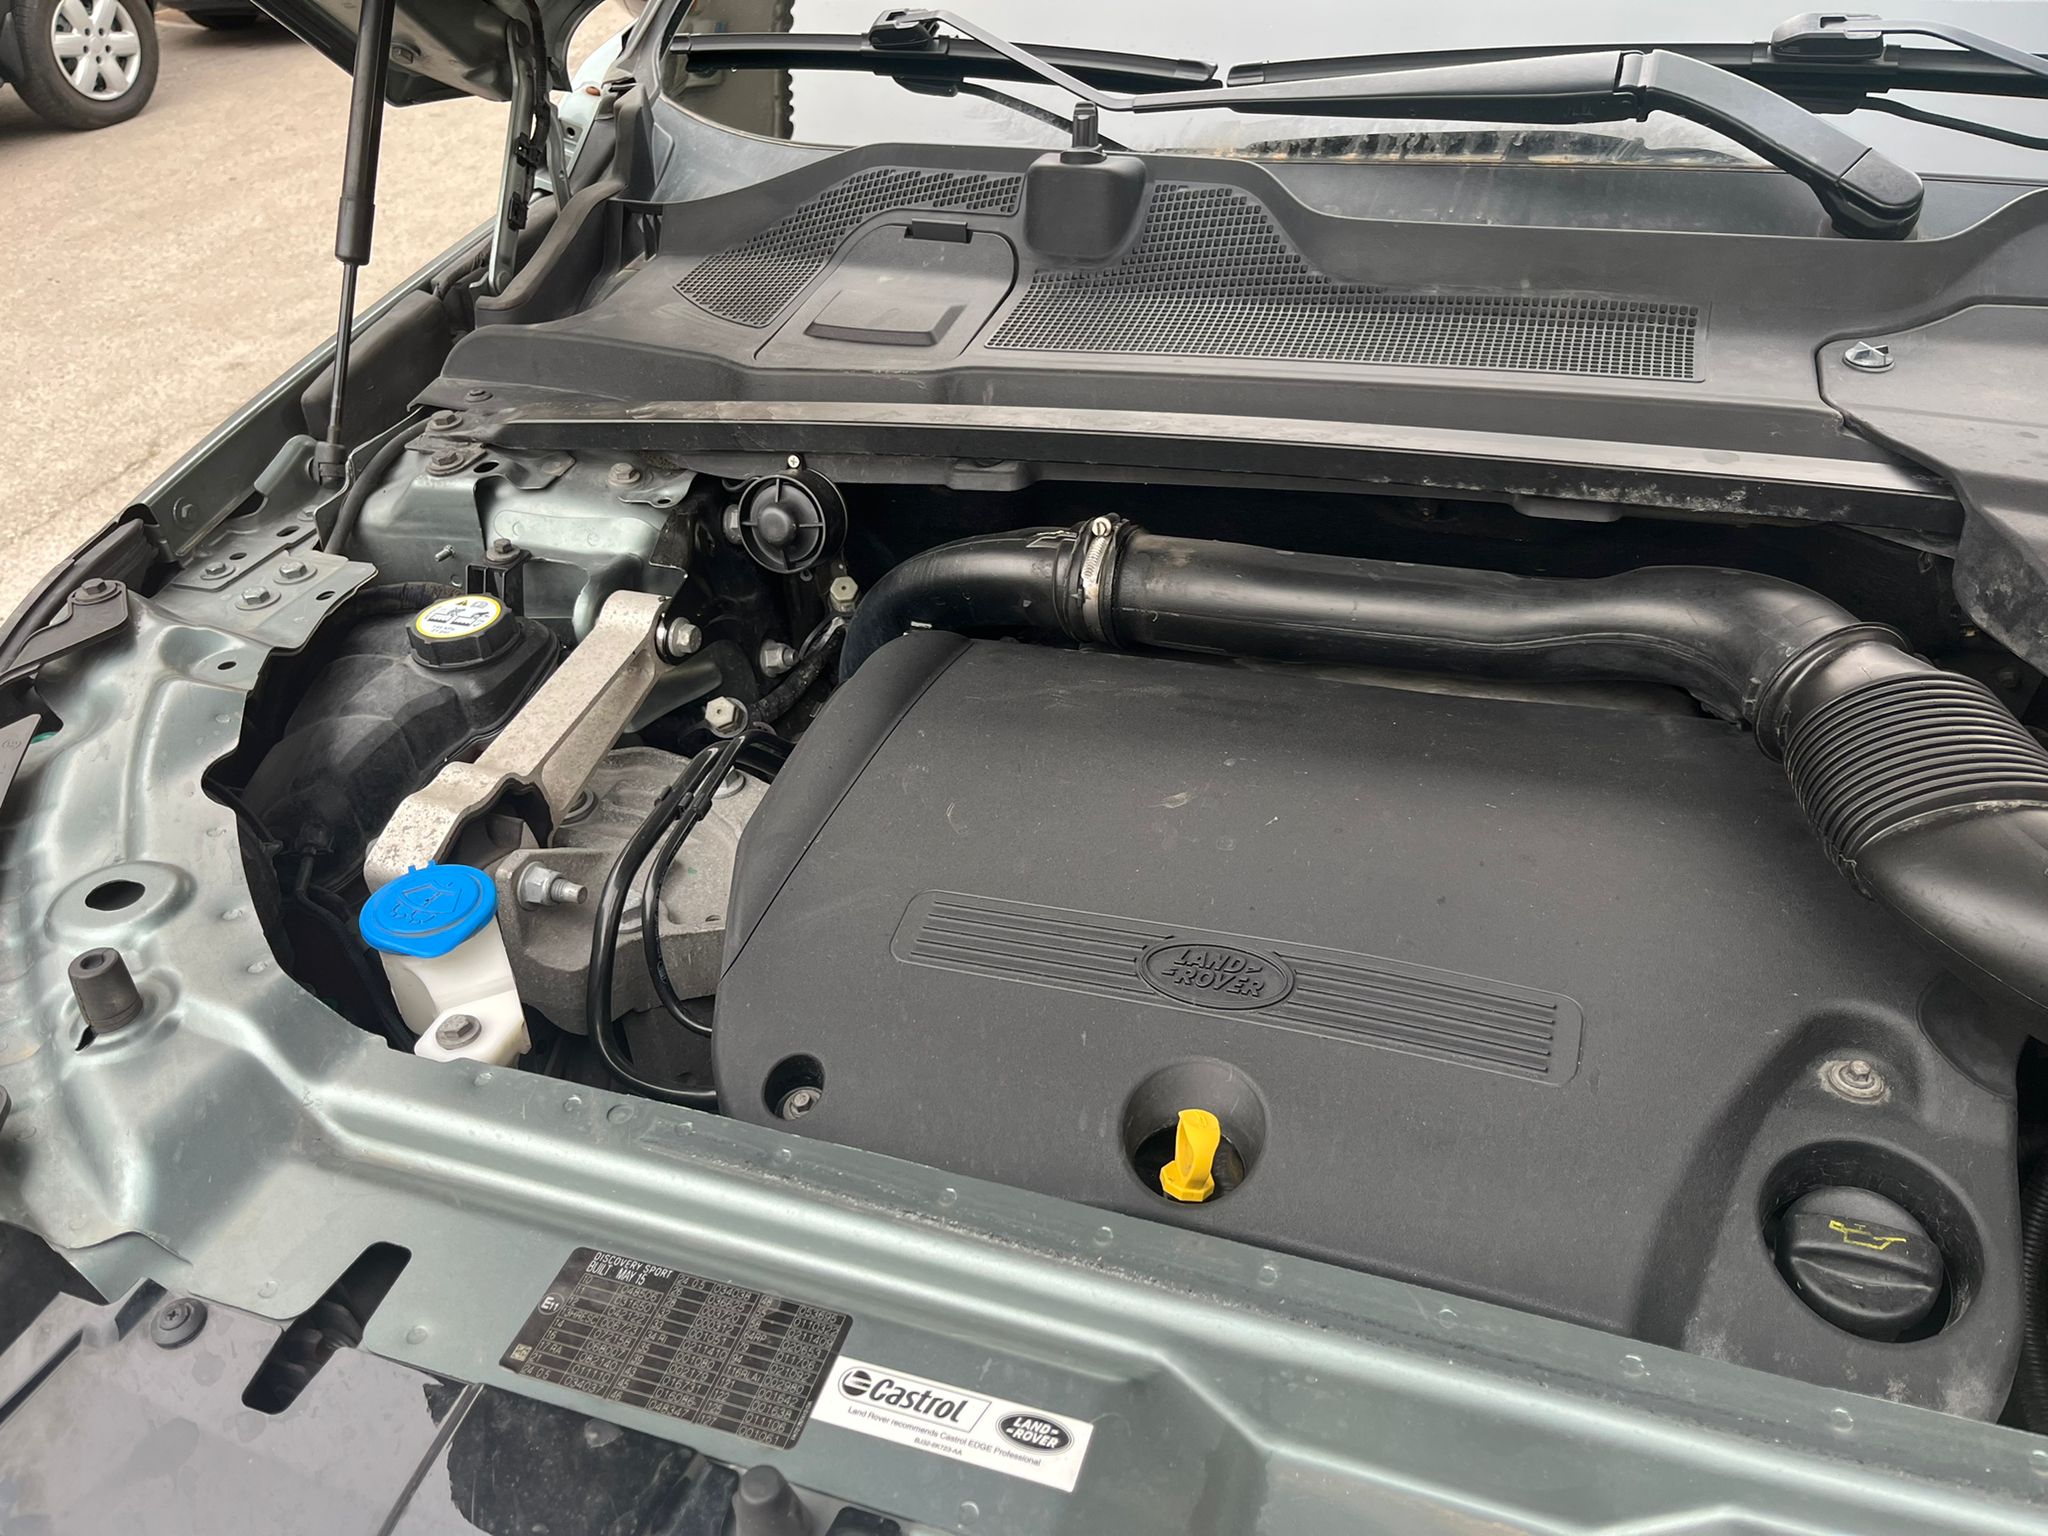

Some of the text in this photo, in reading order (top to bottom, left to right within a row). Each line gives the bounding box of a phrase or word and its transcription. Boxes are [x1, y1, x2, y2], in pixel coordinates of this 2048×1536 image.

[1174, 950, 1247, 974] LAND
[1174, 967, 1264, 997] ROVER
[585, 1261, 647, 1284] BUILT MAY 15
[593, 1252, 672, 1278] DISCOVERY SPORT
[566, 1296, 579, 1306] 12
[552, 1319, 564, 1328] 14
[545, 1330, 557, 1339] 16
[537, 1341, 549, 1351] 17
[529, 1352, 542, 1362] 21
[719, 1377, 735, 1388] 121
[869, 1379, 968, 1423] Castrol
[1013, 1417, 1051, 1435] LAND
[848, 1406, 1041, 1466] Land Rover recommends Castrol EDGE Professional
[1012, 1430, 1061, 1449] ROVER
